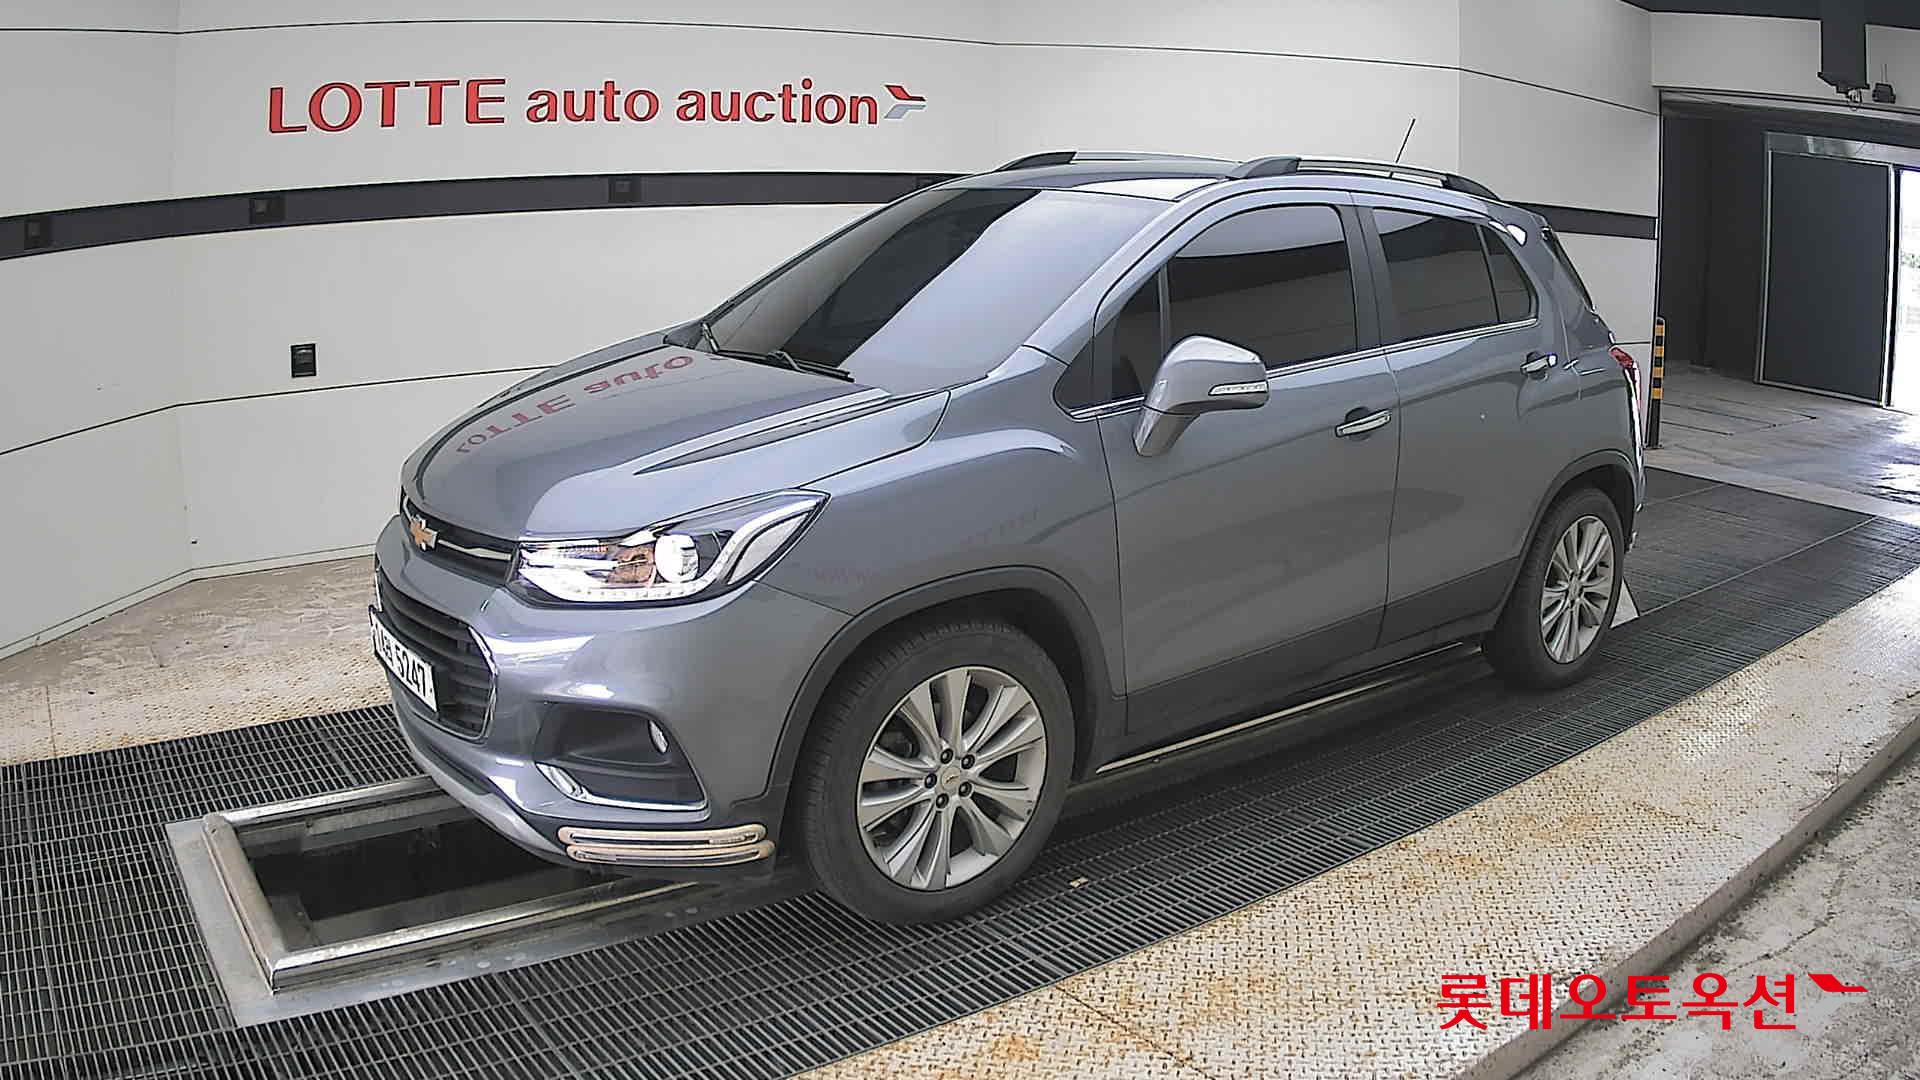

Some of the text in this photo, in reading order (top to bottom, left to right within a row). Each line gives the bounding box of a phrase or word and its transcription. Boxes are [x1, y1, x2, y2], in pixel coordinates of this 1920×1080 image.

[268, 77, 880, 134] LOTTE auto auction
[394, 644, 427, 697] 5247
